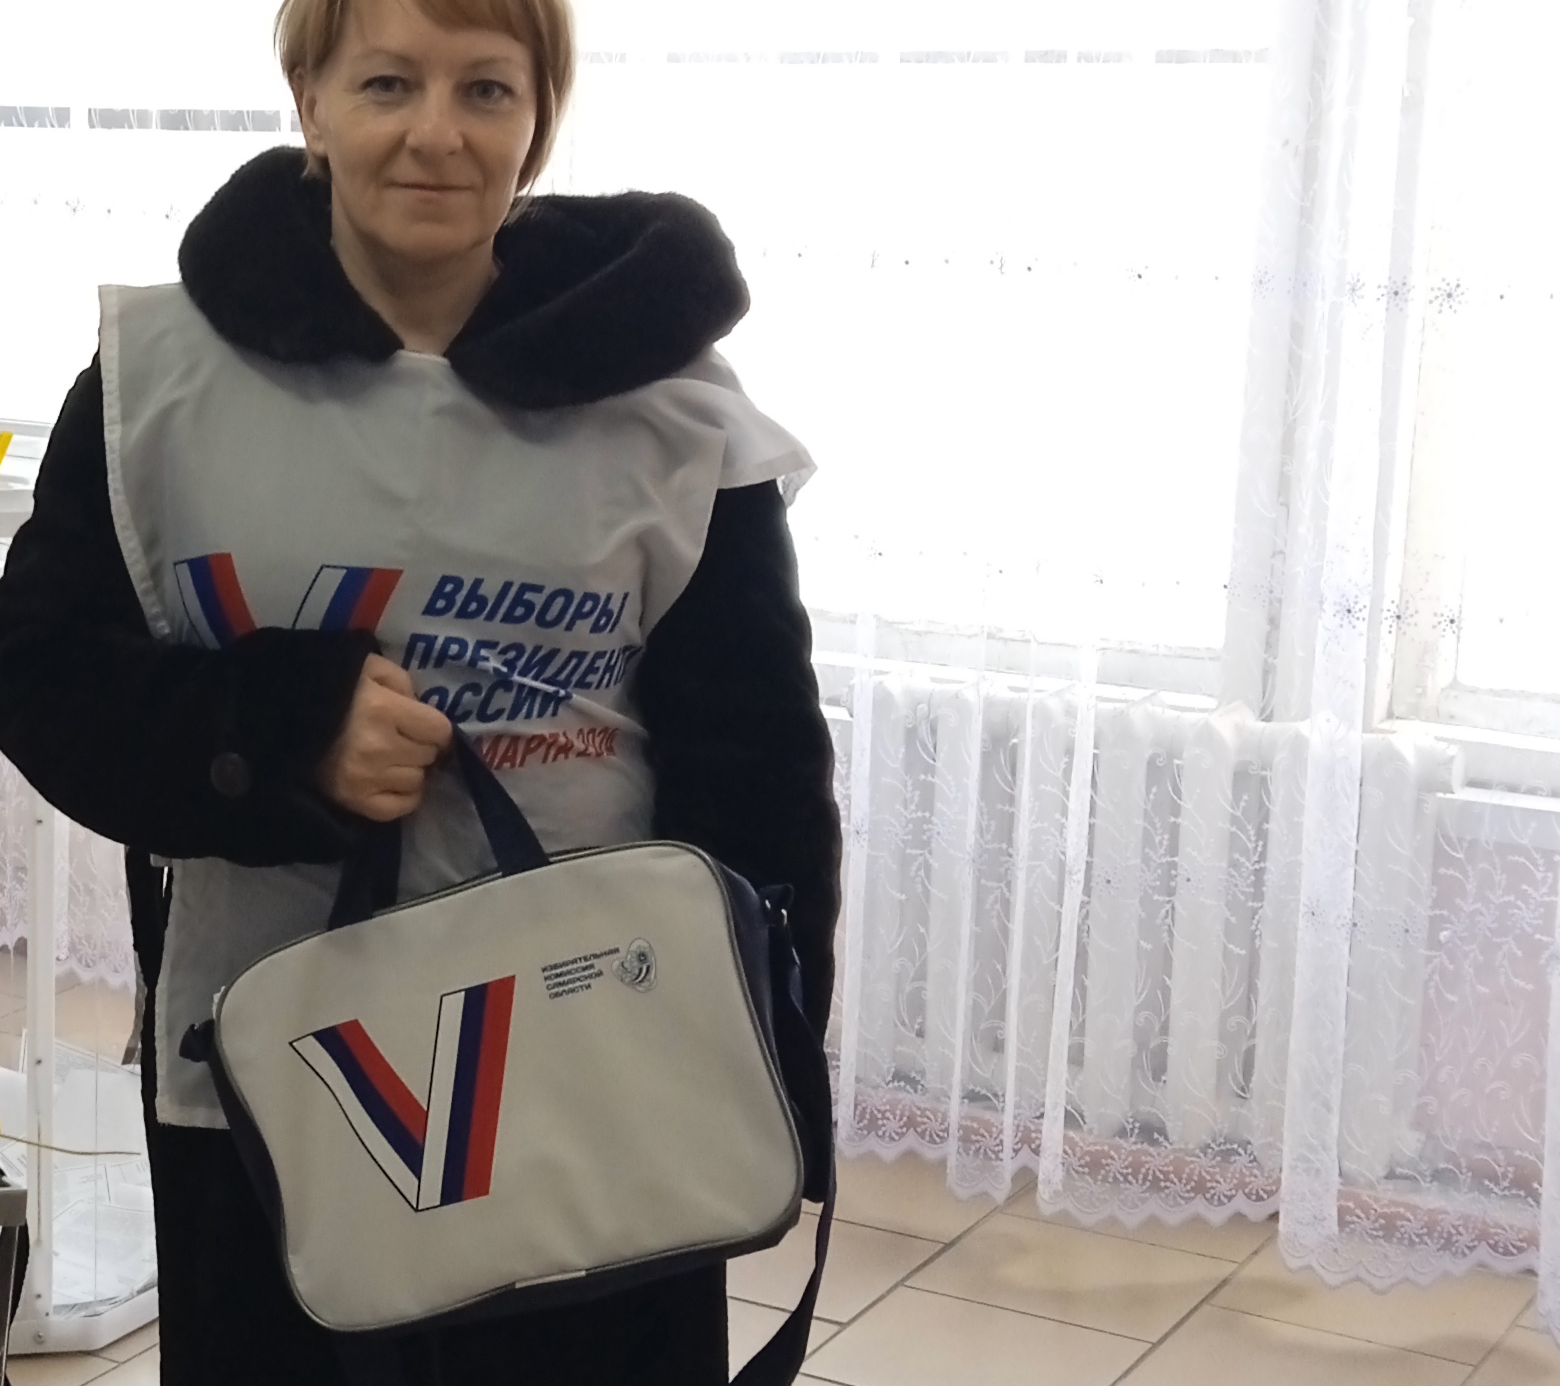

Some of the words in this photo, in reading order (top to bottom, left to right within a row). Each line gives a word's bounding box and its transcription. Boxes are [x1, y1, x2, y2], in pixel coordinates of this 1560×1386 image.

[421, 574, 630, 634] ВЫБОРЫ
[417, 679, 567, 724] ОССИИ
[543, 963, 596, 982] КОМИССИЯ
[545, 969, 604, 992] САМАРСКОЙ
[548, 983, 592, 1000] ОБЛАСТИ
